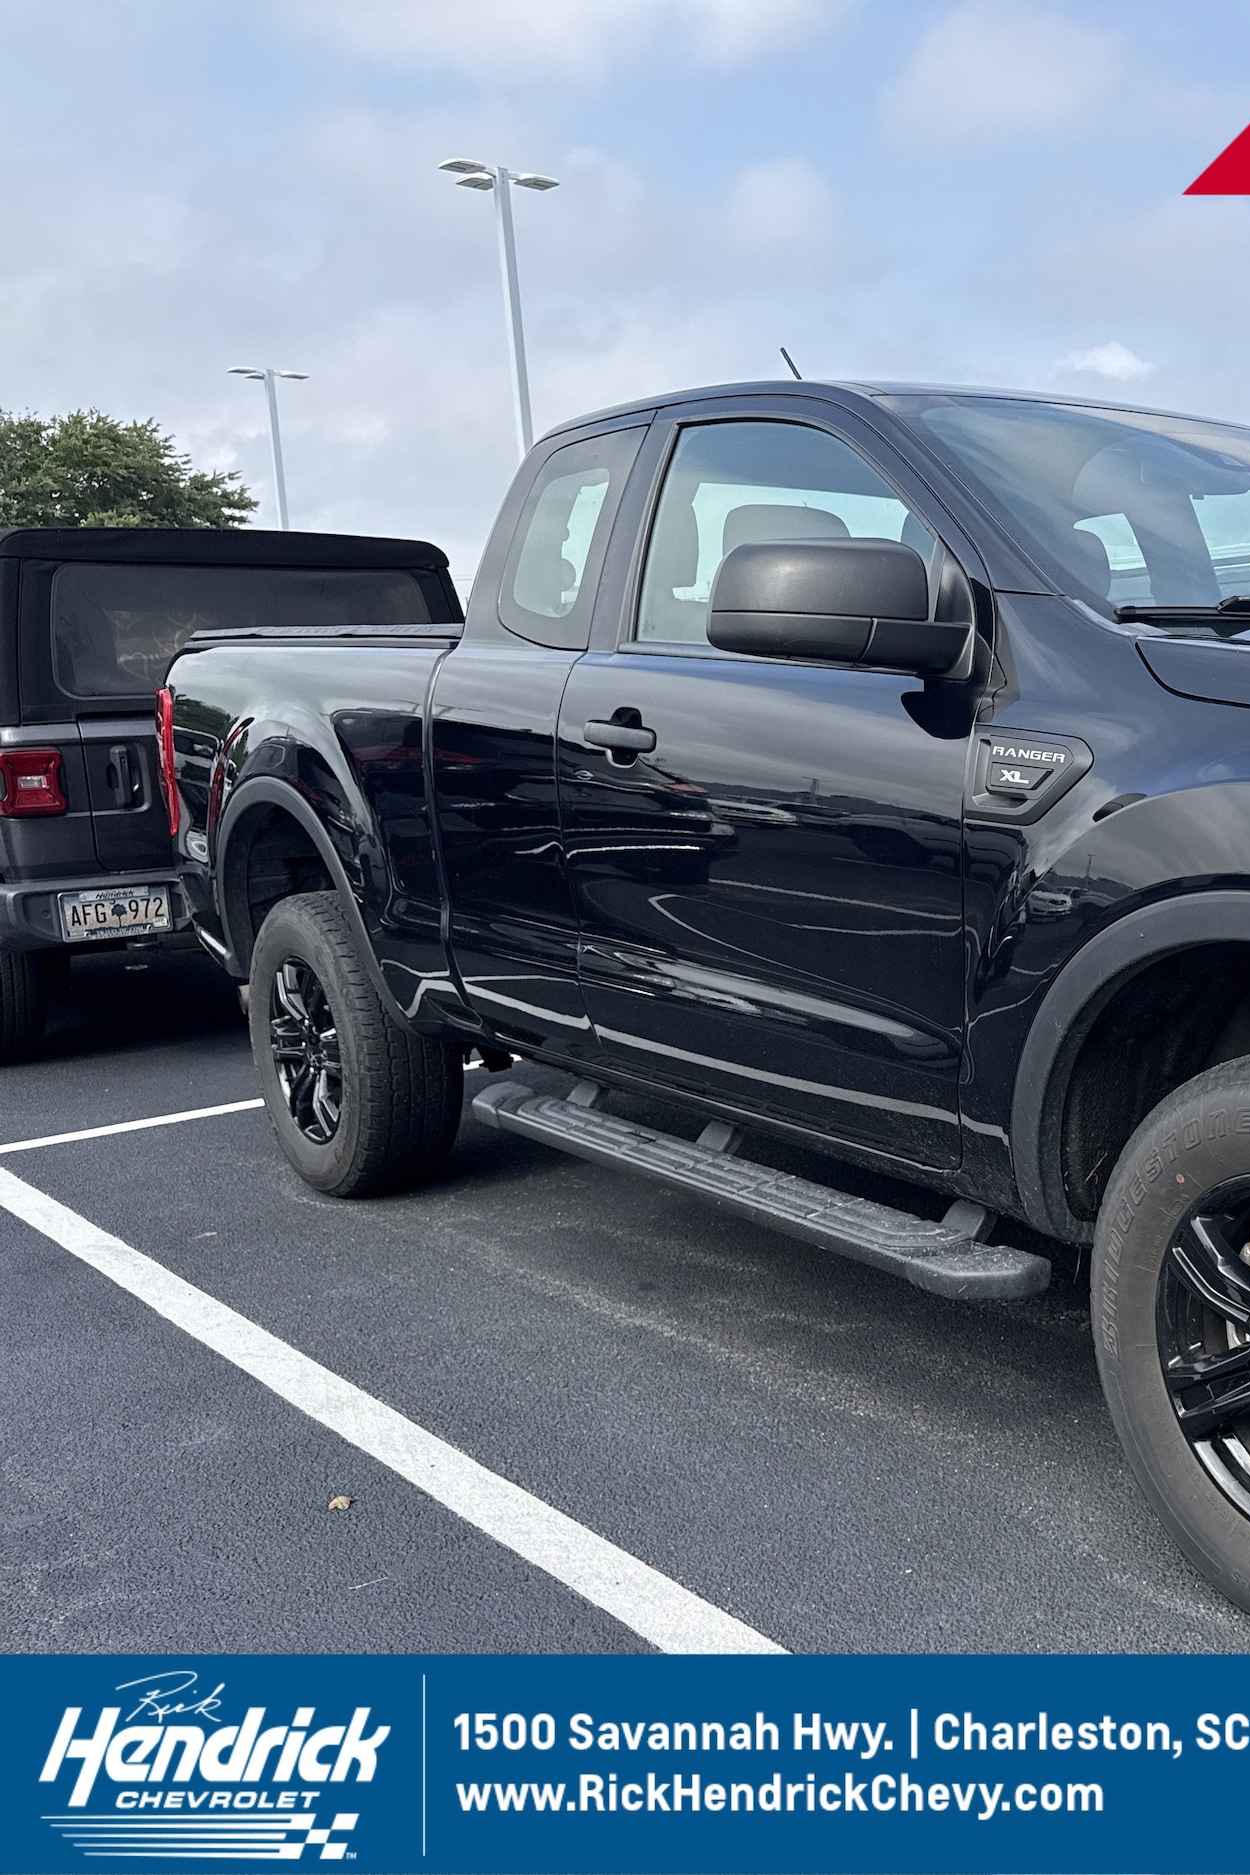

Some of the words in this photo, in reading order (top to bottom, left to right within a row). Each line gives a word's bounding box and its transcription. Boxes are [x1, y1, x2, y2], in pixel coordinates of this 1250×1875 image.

[993, 746, 1066, 763] RANGER
[1000, 769, 1029, 784] XL
[71, 902, 107, 926] AFG
[128, 897, 165, 919] 972
